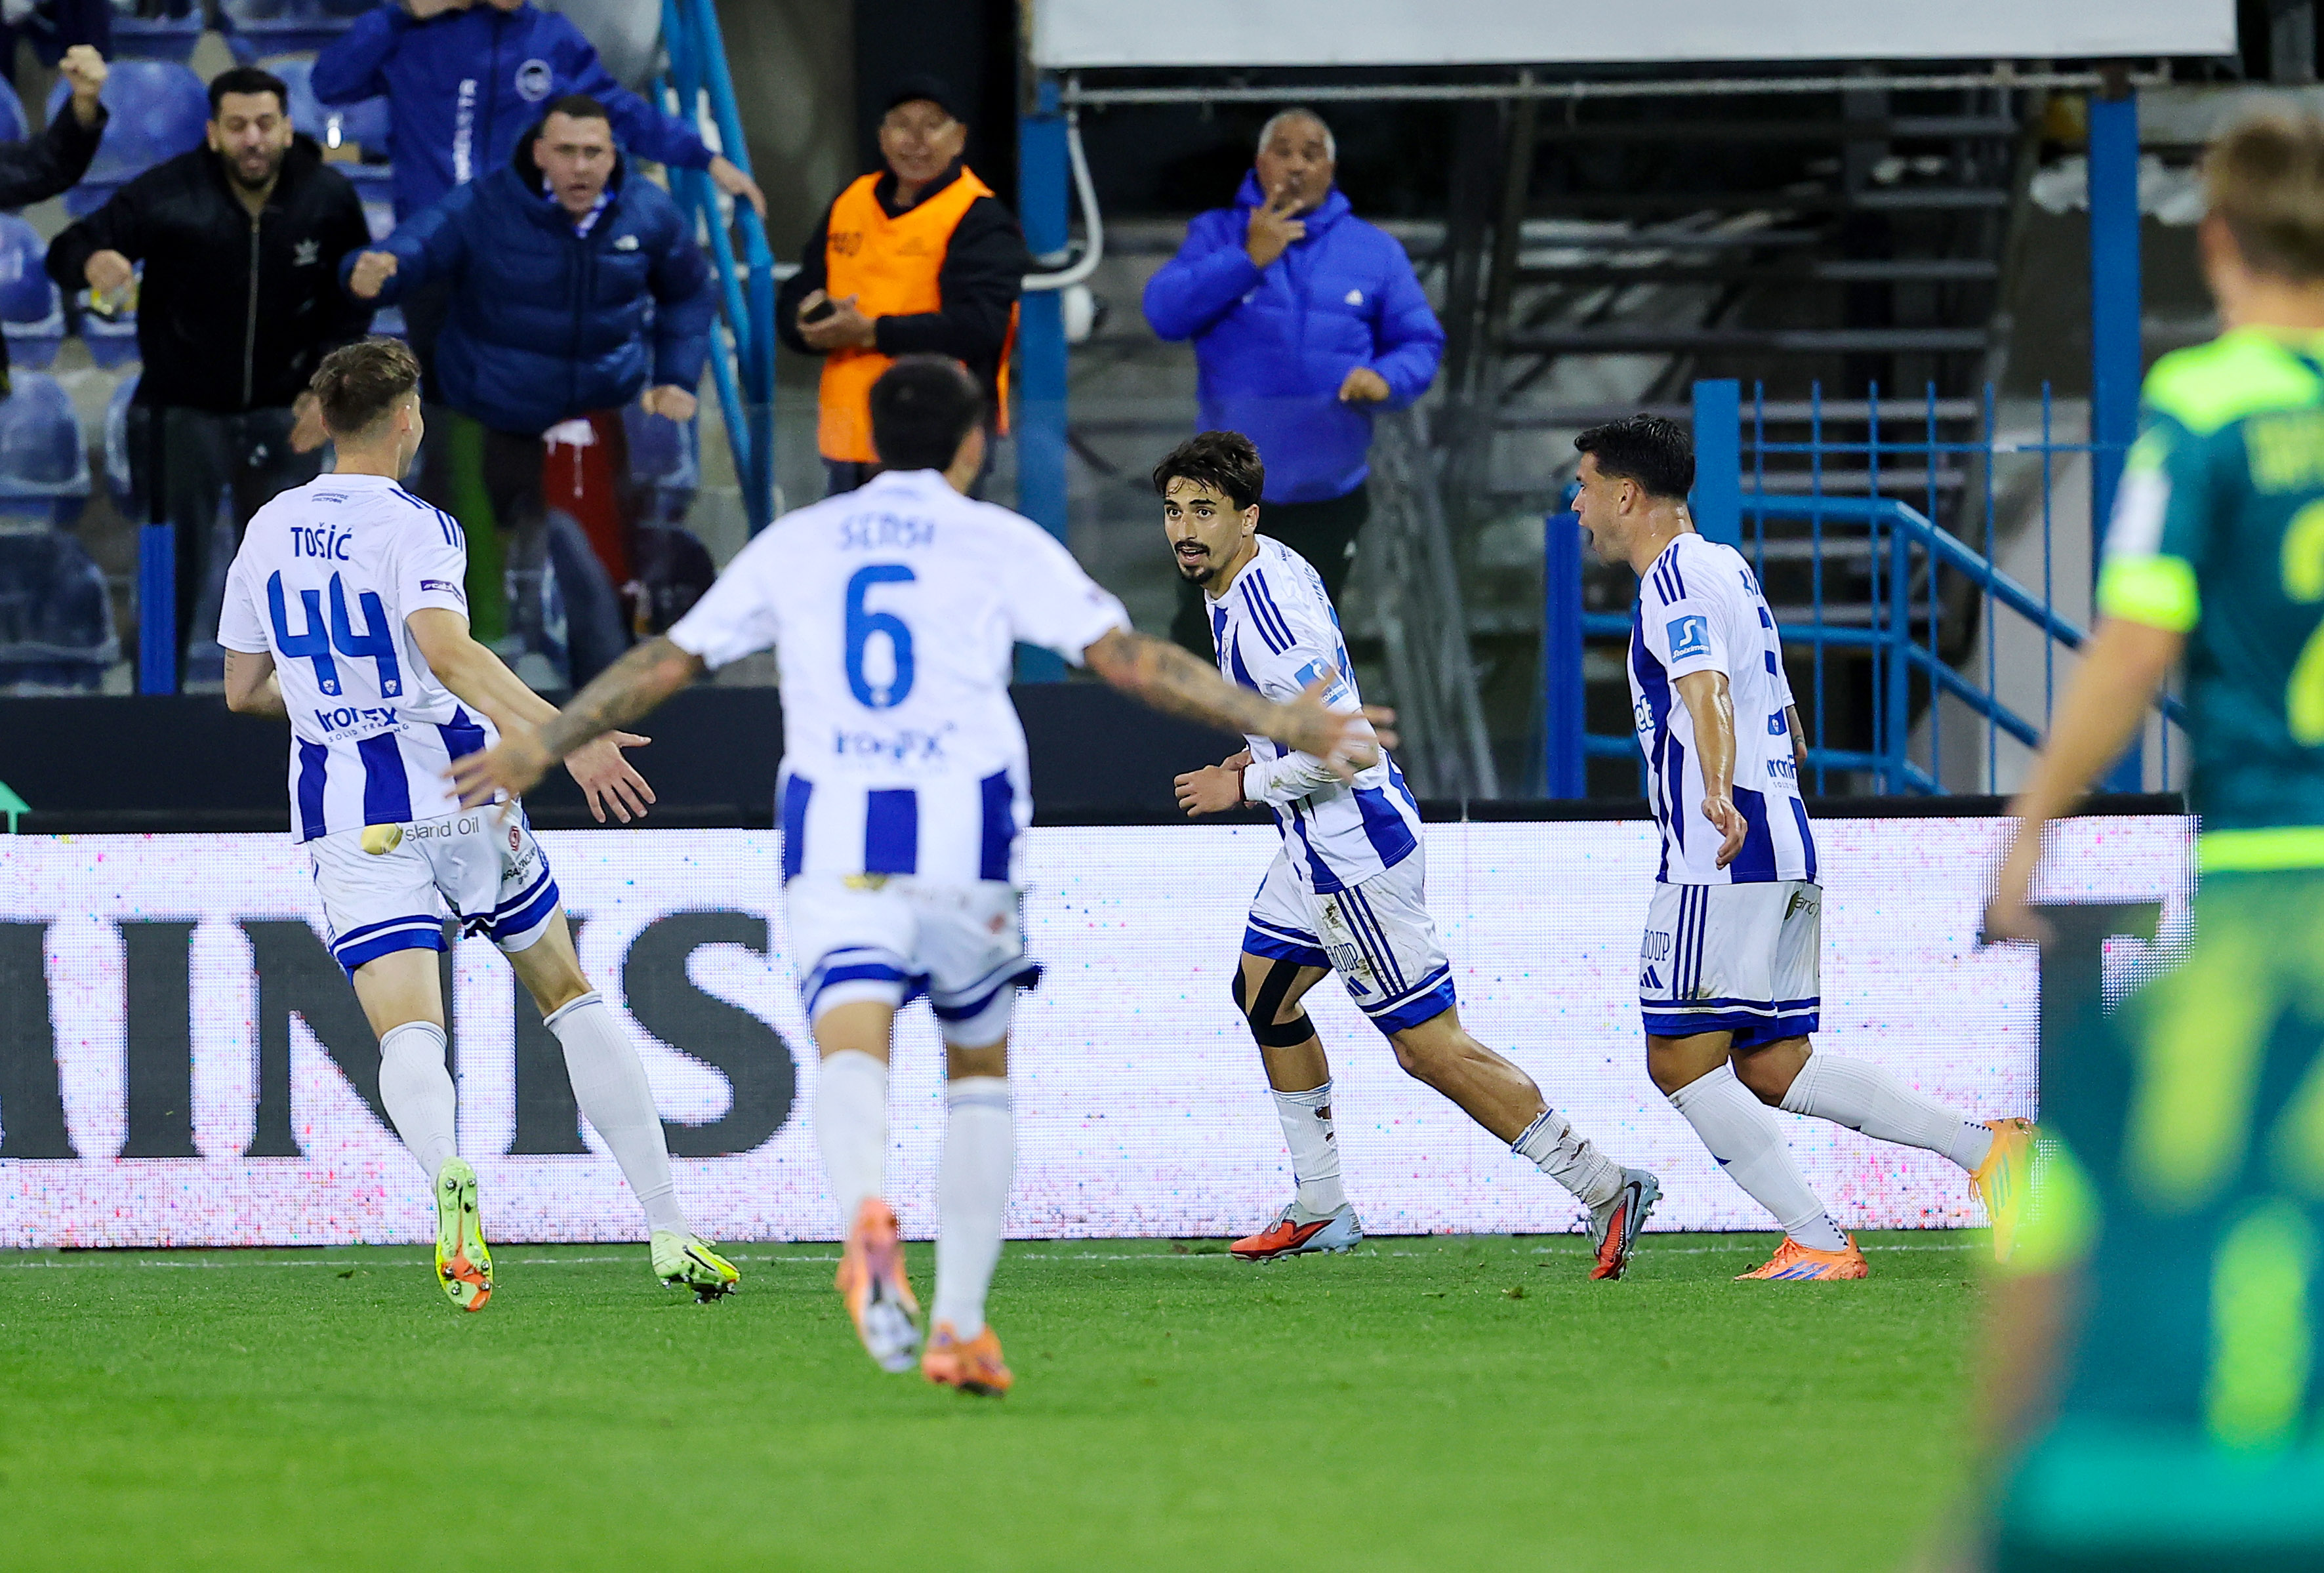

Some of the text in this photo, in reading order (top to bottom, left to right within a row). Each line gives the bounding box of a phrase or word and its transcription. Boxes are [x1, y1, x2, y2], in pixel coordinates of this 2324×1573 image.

[266, 569, 403, 699] 44
[845, 564, 916, 708] 6
[328, 723, 410, 743] SOLID TRANG
[405, 816, 479, 842] sland Oil
